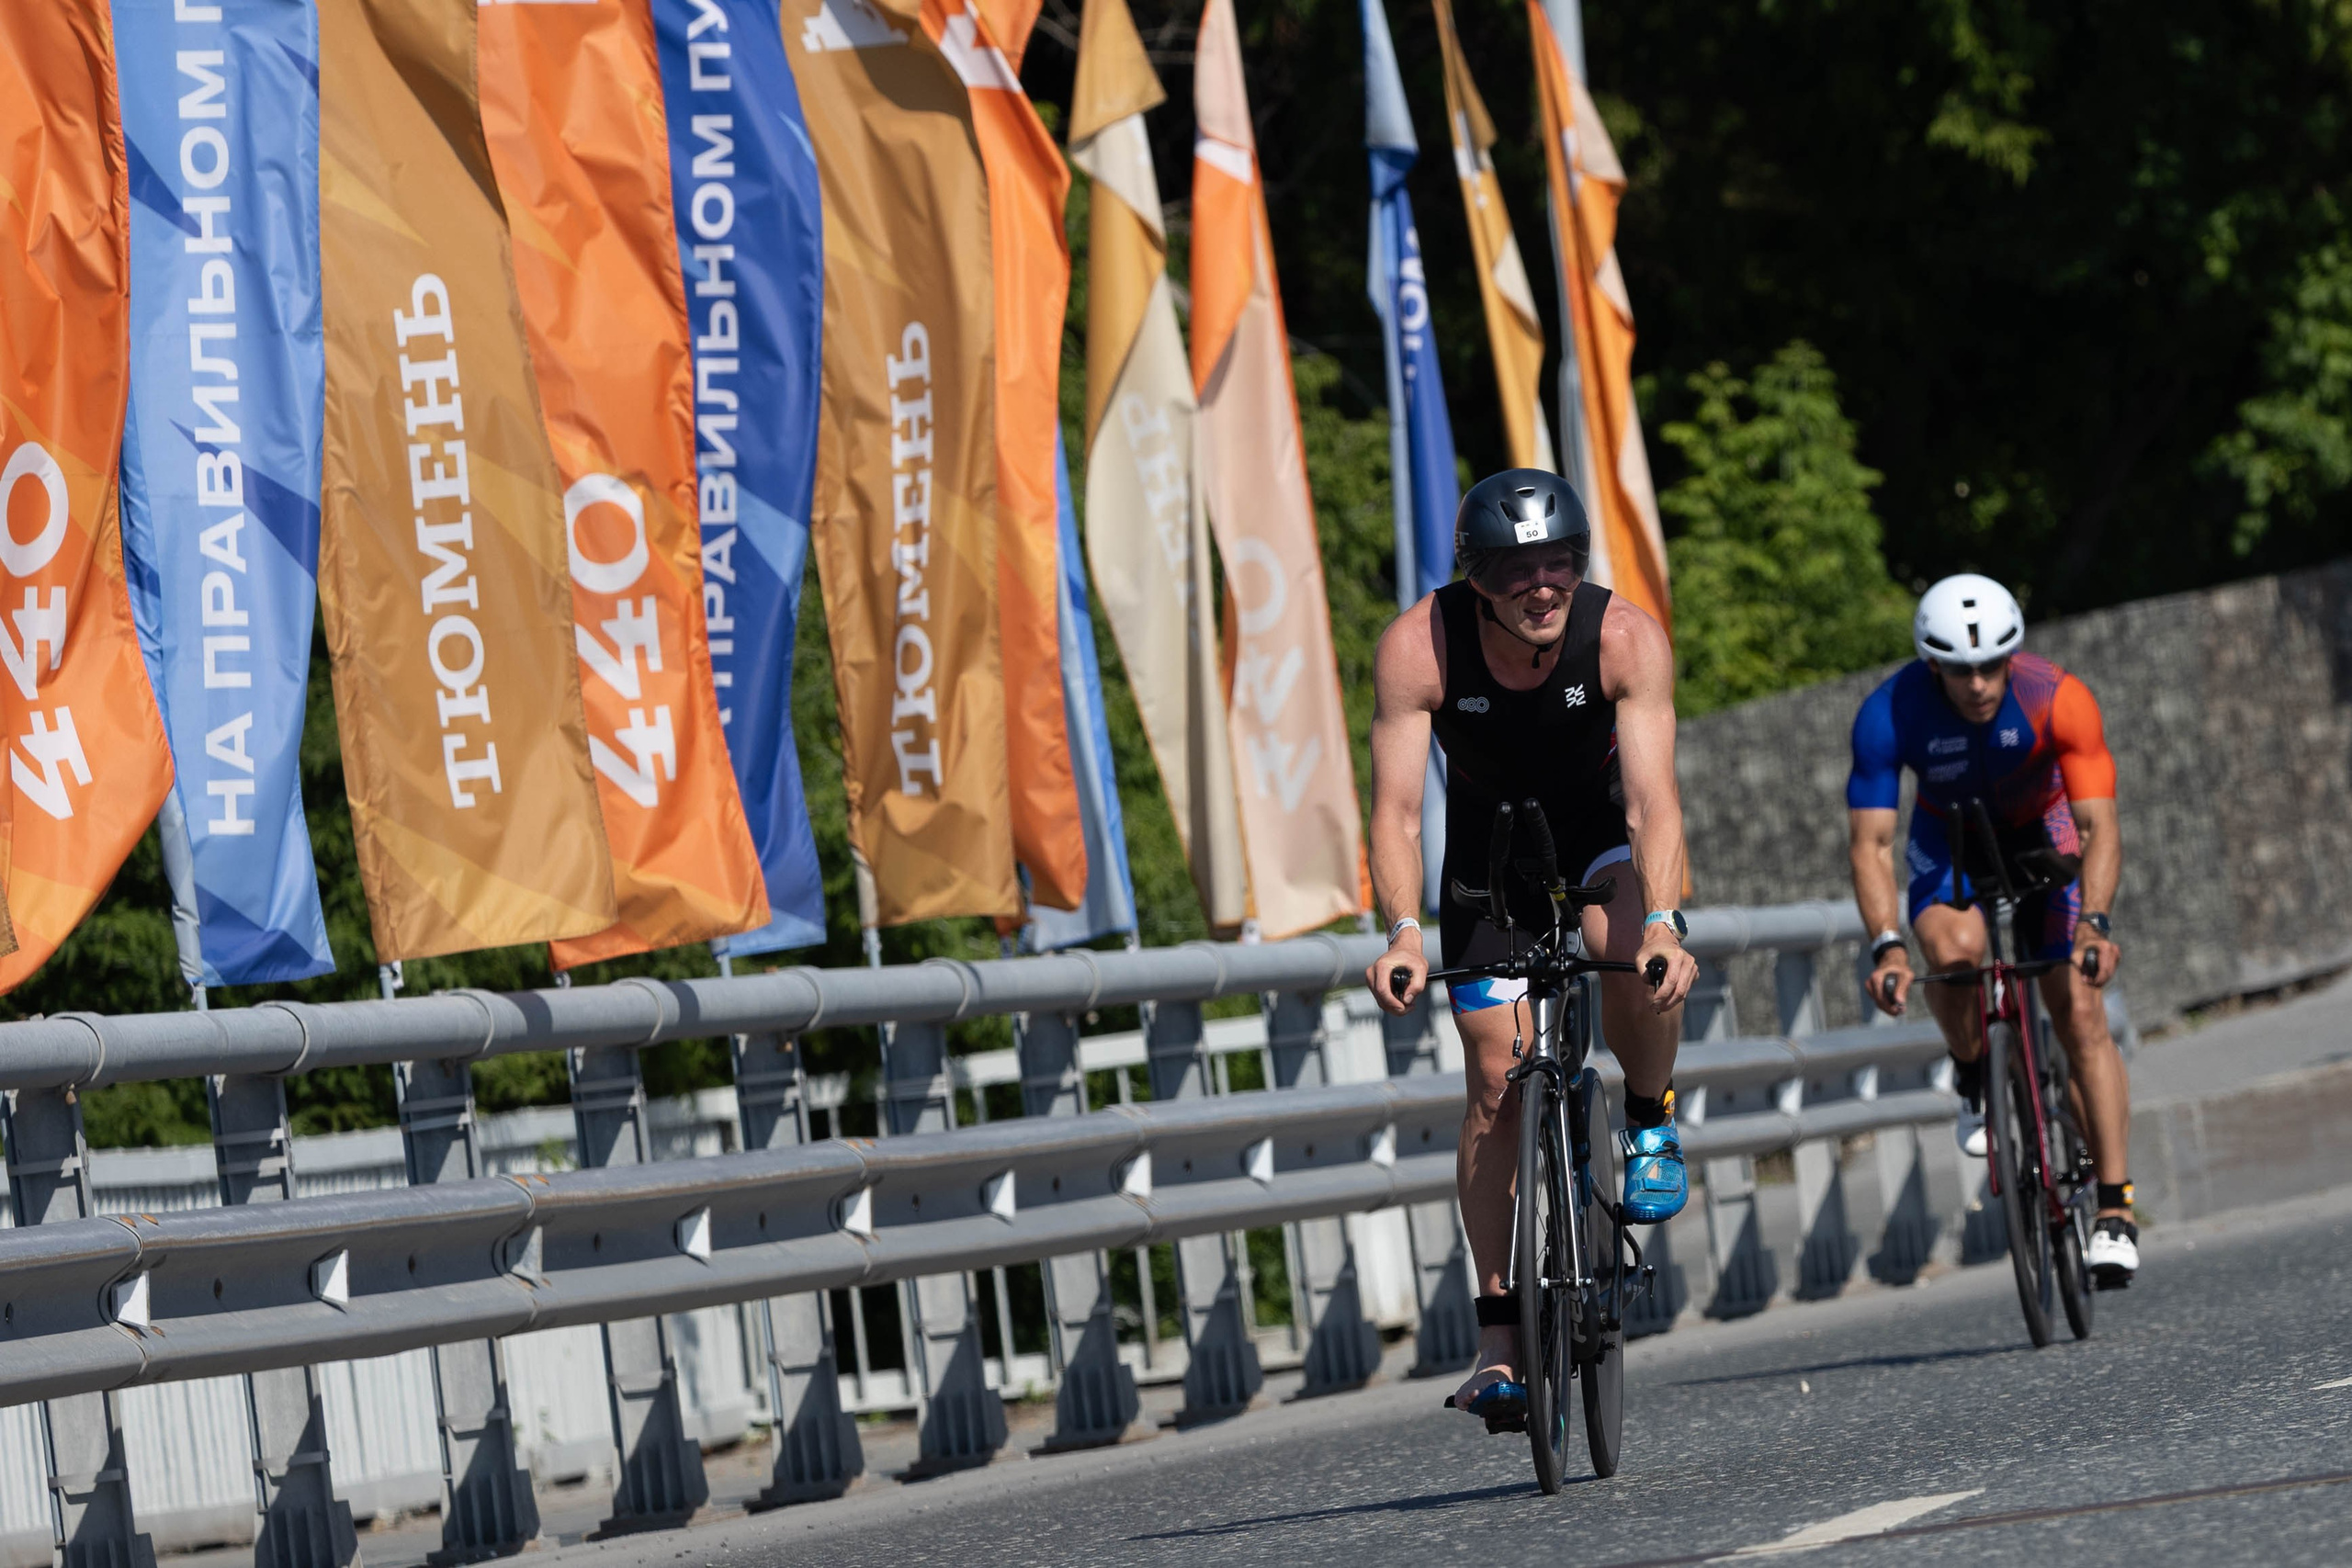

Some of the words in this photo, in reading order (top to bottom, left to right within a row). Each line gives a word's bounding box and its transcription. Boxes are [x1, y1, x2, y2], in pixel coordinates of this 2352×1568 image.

[175, 50, 251, 689] ПРАВИЛЬНОМ
[393, 274, 502, 808] ТЮМЕНЬ
[887, 321, 943, 796] ТЮМЕНЬ
[1526, 529, 1539, 538] 50
[0, 441, 93, 819] 440
[206, 712, 255, 835] НА
[563, 473, 676, 807] 440
